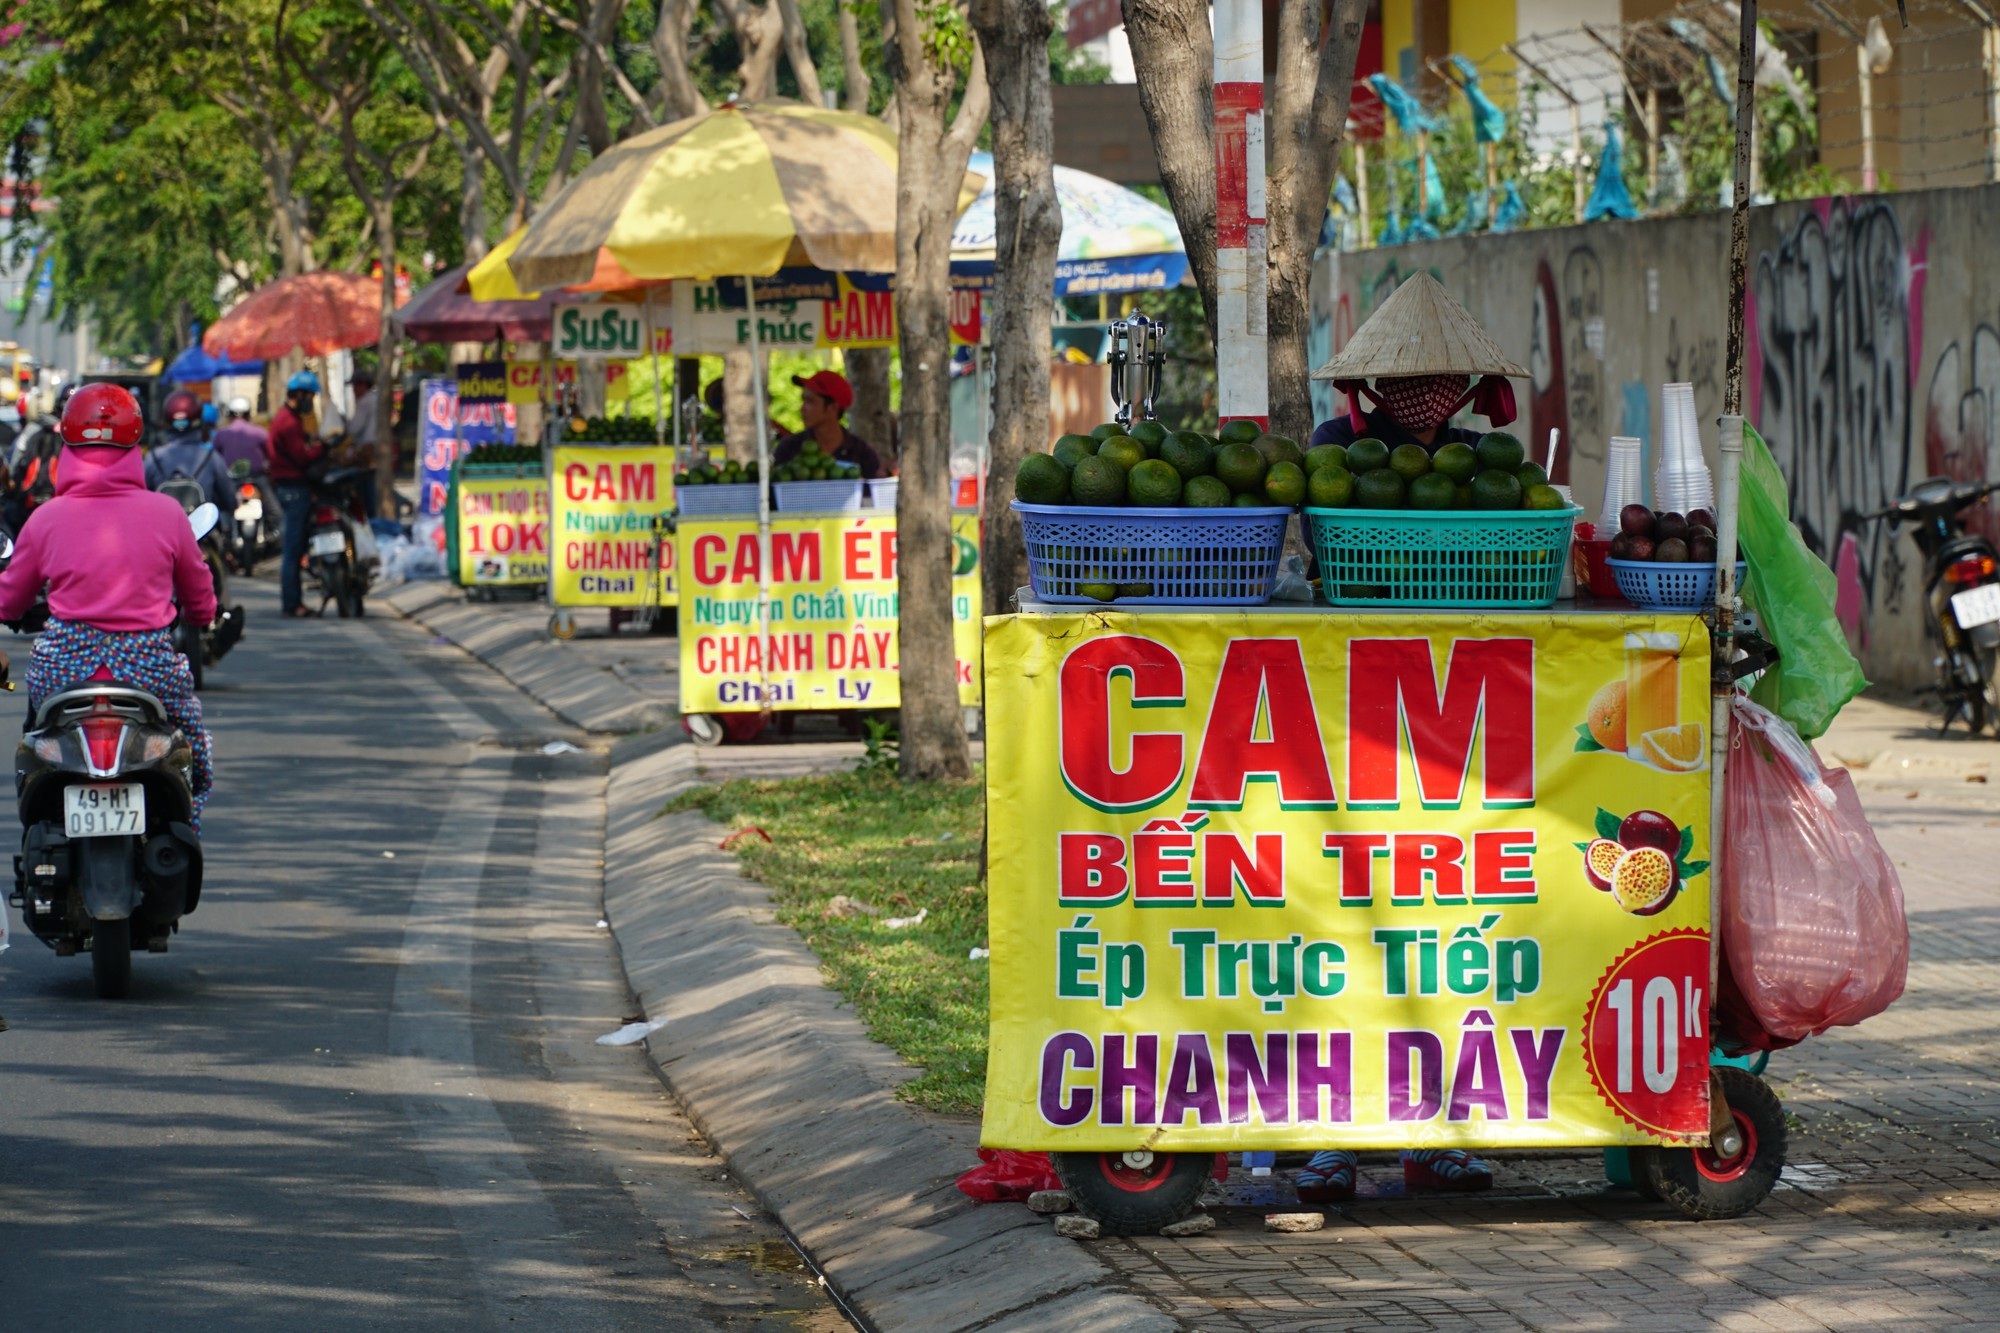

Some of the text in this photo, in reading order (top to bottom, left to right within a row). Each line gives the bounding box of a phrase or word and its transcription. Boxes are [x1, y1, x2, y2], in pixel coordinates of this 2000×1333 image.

[560, 308, 639, 351] SuSu
[737, 315, 814, 344] Phúc
[822, 291, 894, 341] CAM
[565, 463, 655, 502] CAM
[468, 523, 547, 553] 10K
[566, 508, 652, 534] Nguyên
[566, 541, 650, 571] CHANH
[693, 532, 821, 586] CAM
[580, 576, 635, 593] Chai
[792, 587, 846, 620] Chất
[697, 623, 892, 674] CHANH DÂY
[718, 680, 794, 703] Chai
[838, 678, 872, 701] Ly
[1059, 634, 1537, 814] CAM
[71, 810, 139, 833] 091.77
[1058, 809, 1539, 907] BẾN TRE
[1057, 913, 1542, 1014] Ép Trực Tiếp
[1608, 976, 1703, 1093] 10k
[1038, 1008, 1567, 1127] CHANH DÂY
